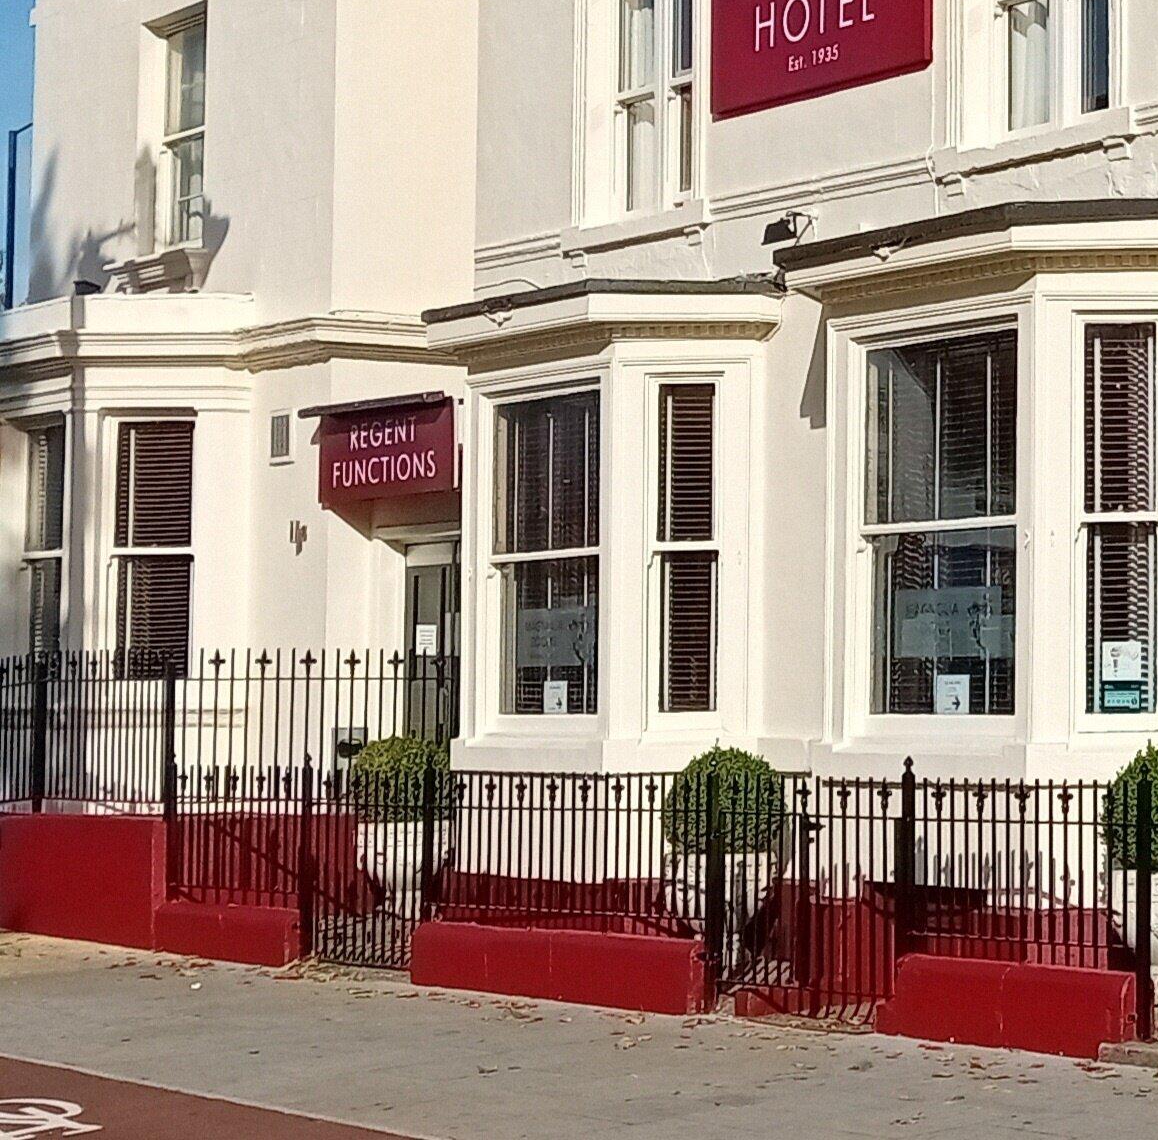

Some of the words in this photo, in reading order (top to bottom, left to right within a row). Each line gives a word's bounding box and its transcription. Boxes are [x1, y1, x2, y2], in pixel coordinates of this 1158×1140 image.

[788, 55, 807, 72] Est.
[811, 44, 839, 66] 1935
[350, 416, 417, 451] REGENT
[332, 450, 436, 488] FUNCTIONS
